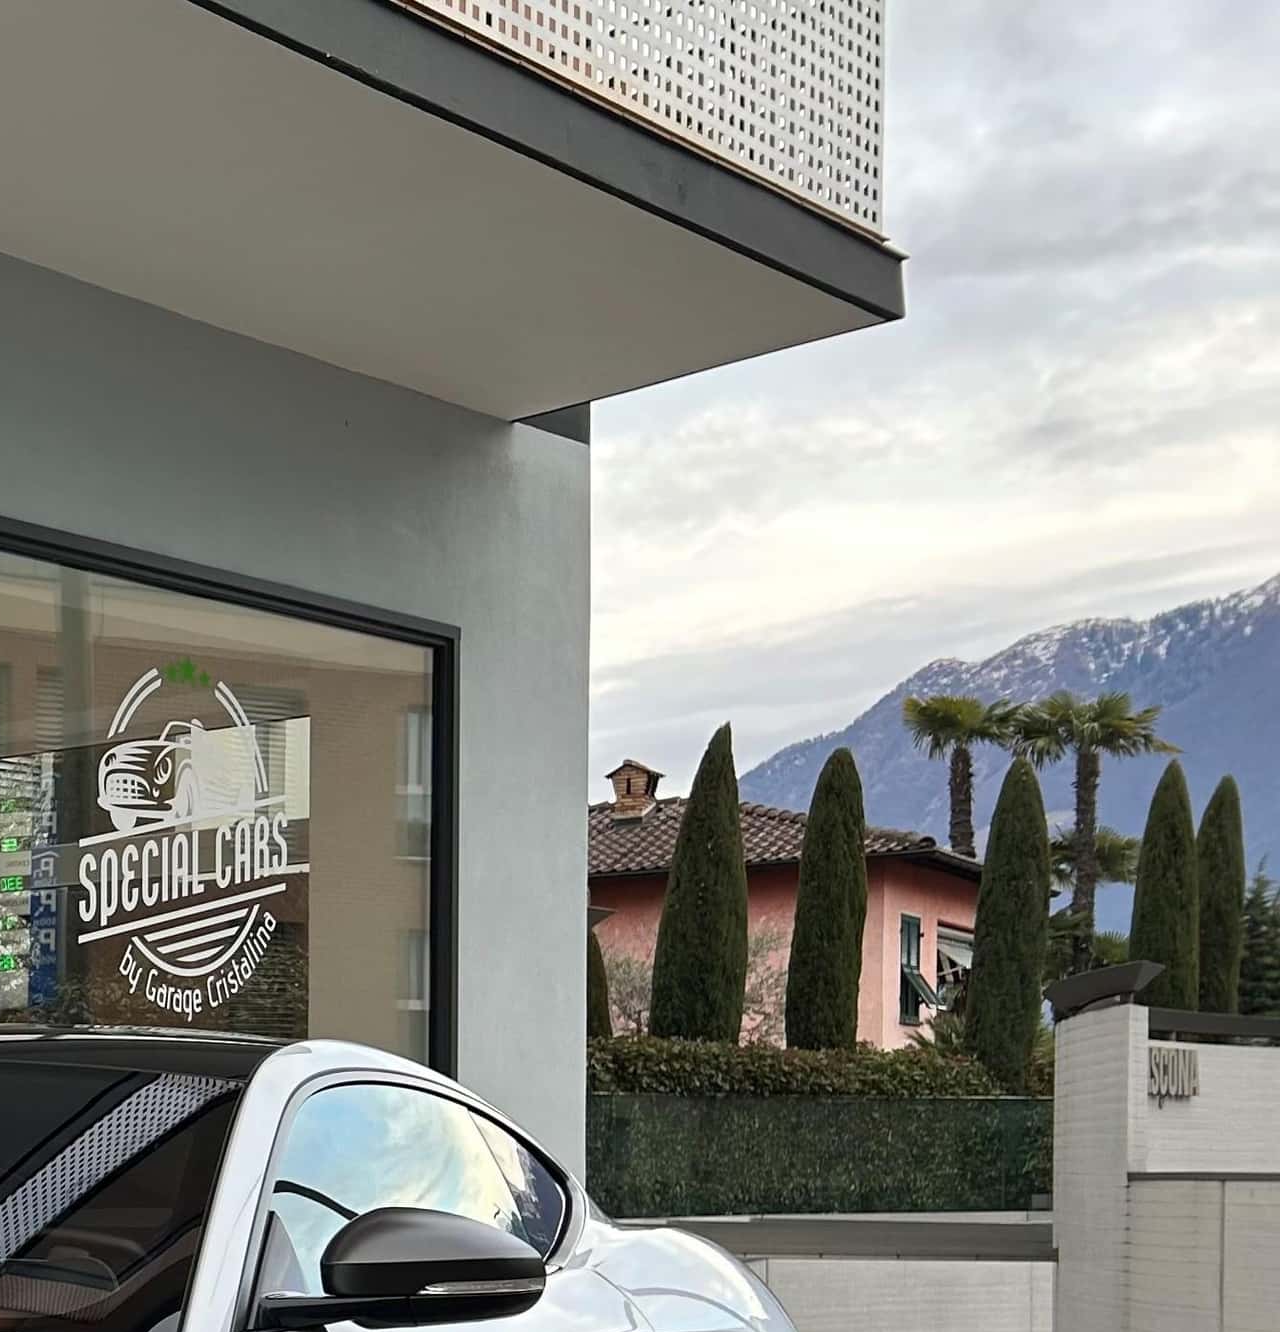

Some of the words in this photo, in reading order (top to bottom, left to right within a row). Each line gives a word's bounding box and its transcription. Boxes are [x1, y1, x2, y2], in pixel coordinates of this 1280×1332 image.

[78, 832, 205, 928] SPECIAL
[215, 811, 289, 889] CARS
[119, 945, 143, 994] by
[146, 969, 202, 1022] Garage
[207, 911, 277, 1008] Cristallina
[1147, 1047, 1200, 1097] SCONA
